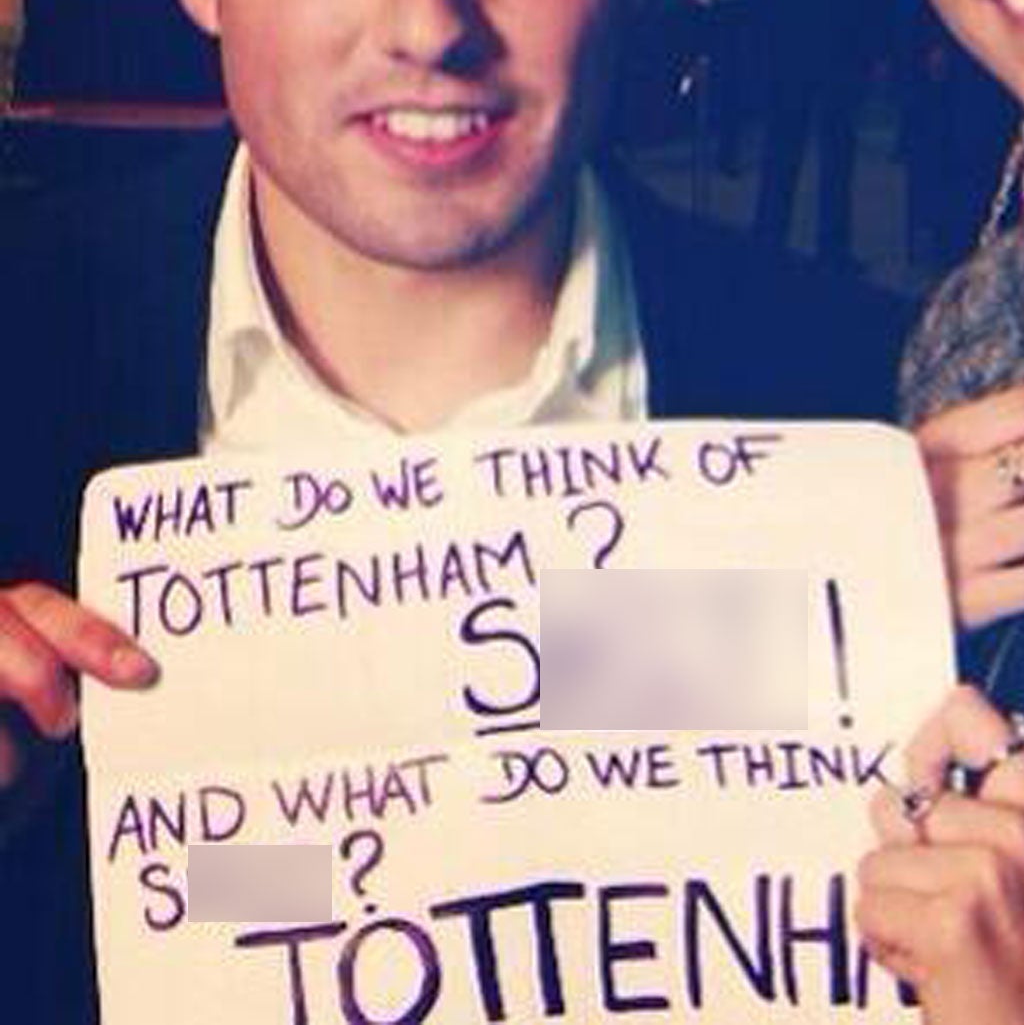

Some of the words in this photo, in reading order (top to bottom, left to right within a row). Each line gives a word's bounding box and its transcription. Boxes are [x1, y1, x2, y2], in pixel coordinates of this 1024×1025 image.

[113, 479, 253, 542] WHAT
[276, 471, 353, 530] DO
[370, 457, 444, 511] WE
[474, 437, 670, 498] THINK
[698, 434, 785, 485] OF
[116, 531, 536, 637] TOTTENHAM
[107, 786, 246, 863] AND
[271, 754, 448, 827] WHAT
[479, 748, 569, 803] DO
[586, 745, 679, 788] WE
[696, 741, 900, 790] THINK
